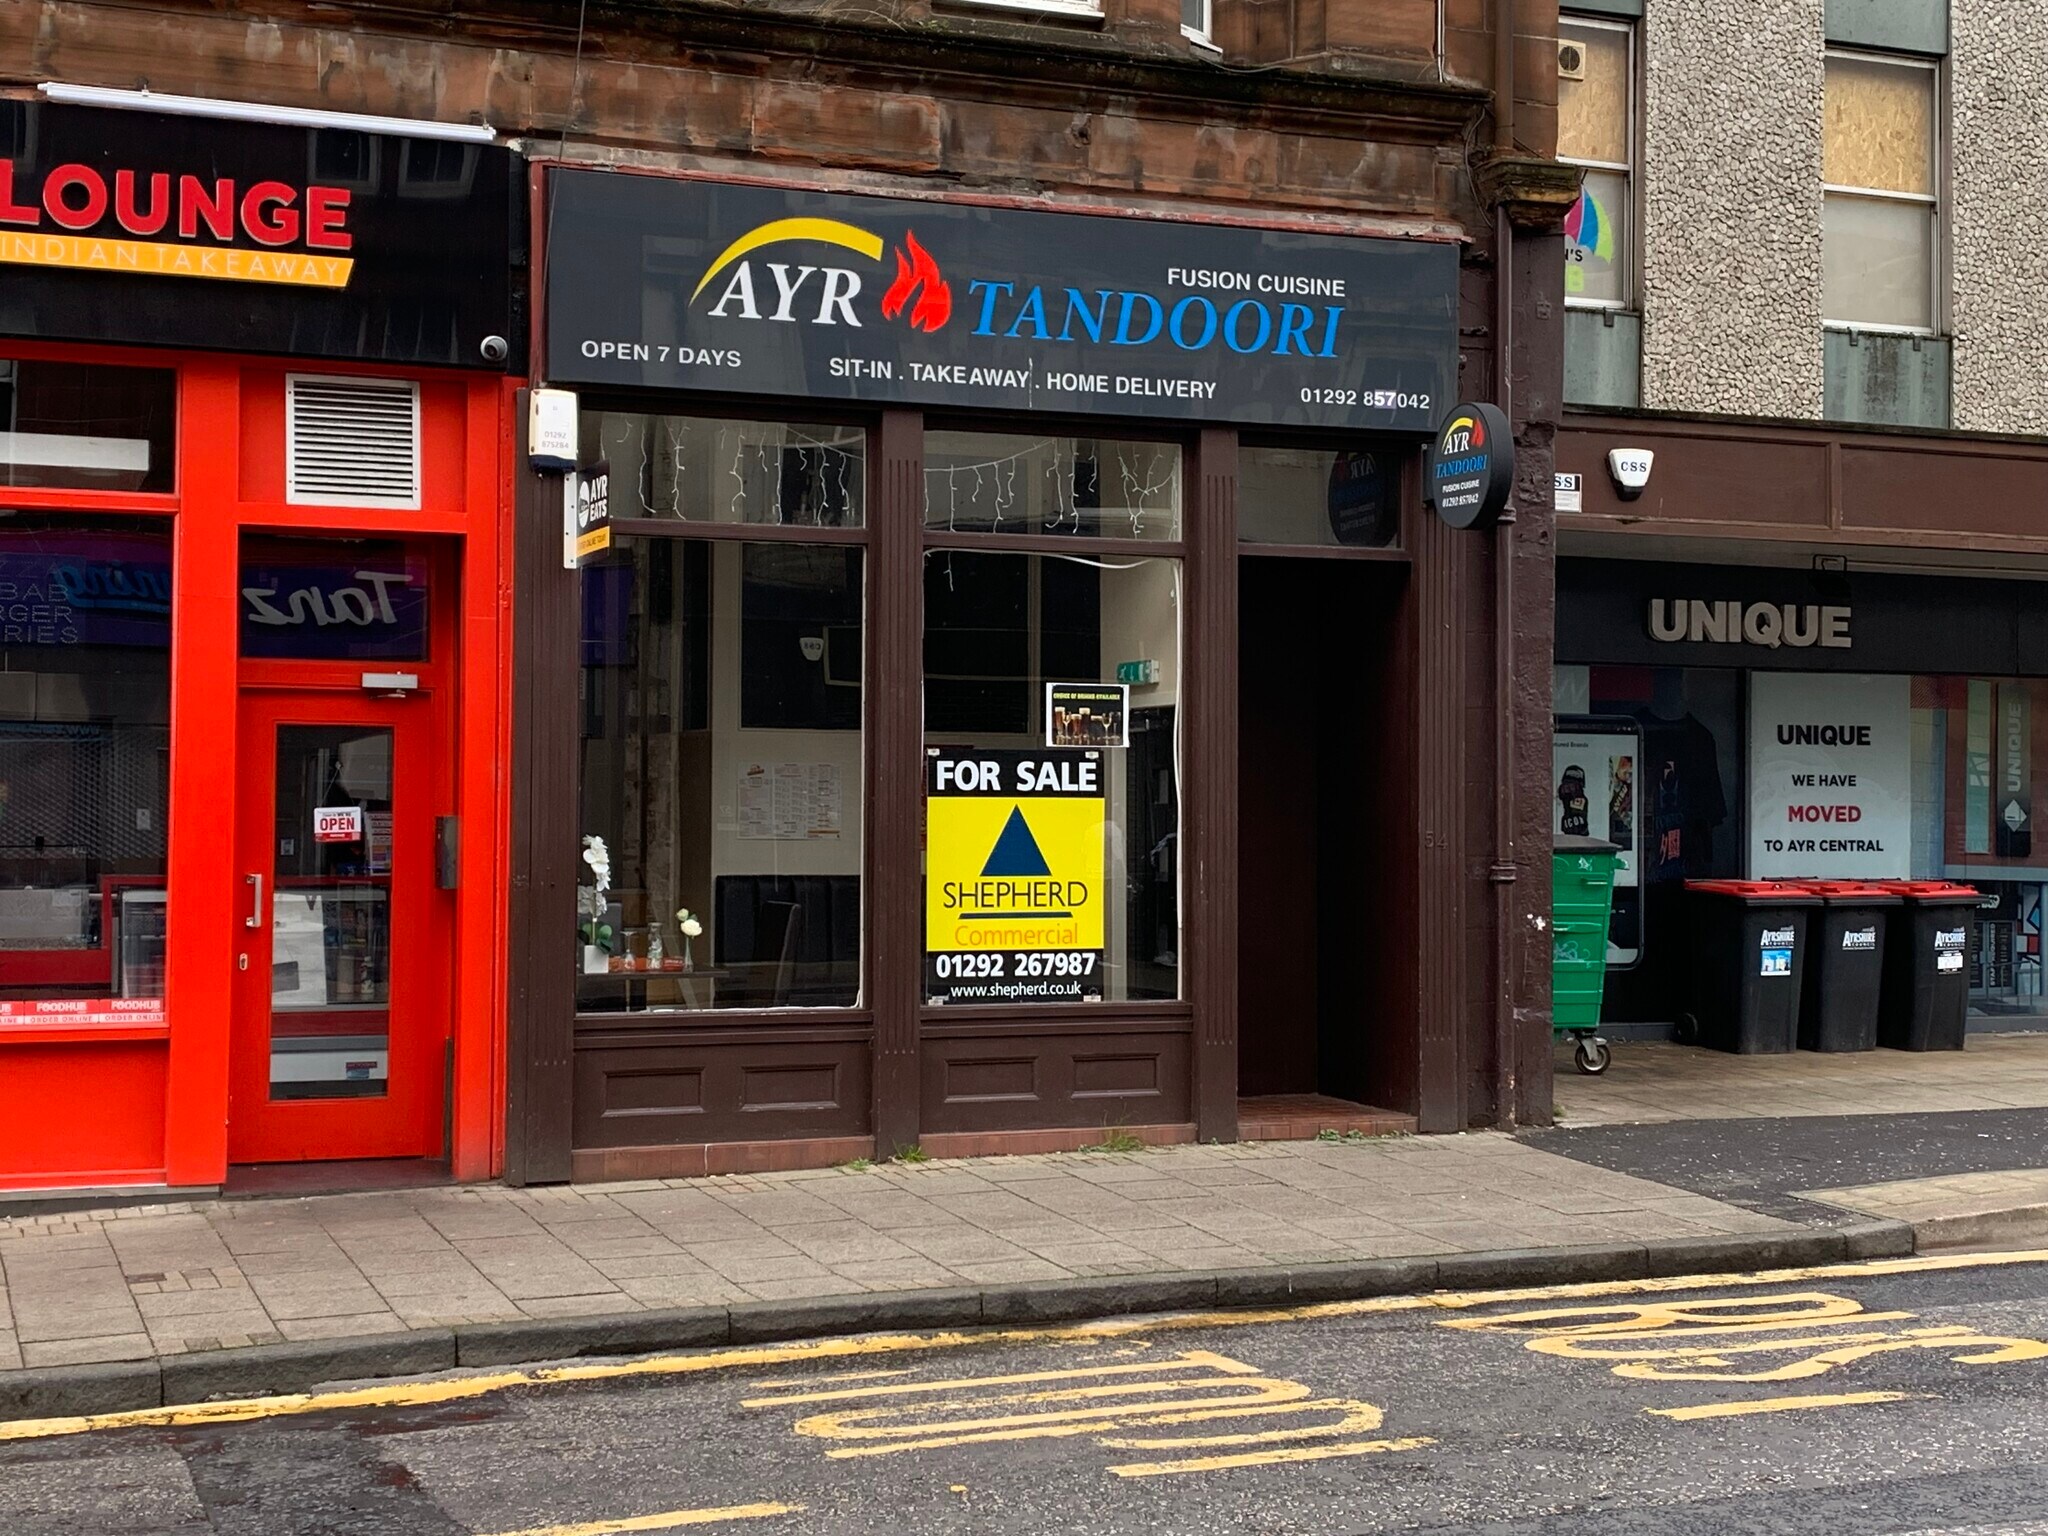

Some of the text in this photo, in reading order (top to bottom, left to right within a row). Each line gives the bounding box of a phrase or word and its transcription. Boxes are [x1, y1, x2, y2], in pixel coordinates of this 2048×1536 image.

[0, 159, 353, 250] LOUNGE
[1, 235, 338, 282] INDIAN TAKEAWAY
[707, 261, 863, 327] AYR
[1167, 268, 1346, 297] FUSION CUISINE
[968, 279, 1346, 358] TANDOORI
[581, 340, 742, 368] OPEN 7 DAYS
[830, 357, 1217, 400] SIT-IN TAKEAWAY HOME DELIVERY
[1300, 387, 1431, 410] 01292 857042
[1444, 431, 1470, 455] AYR
[1436, 454, 1488, 479] TANDOORI
[1620, 461, 1647, 473] CSS
[590, 474, 608, 500] AYR
[1442, 482, 1460, 494] FUSION
[589, 498, 608, 523] EATS
[1648, 598, 1852, 649] UNIQUE
[1777, 724, 1871, 747] UNIQUE
[2008, 703, 2022, 792] UNIQUE
[936, 760, 1097, 792] FOR SALE
[1792, 774, 1856, 787] WE HAVE
[319, 817, 355, 831] OPEN
[1788, 805, 1861, 822] MOVED
[1764, 840, 1884, 852] TO AYR CENTRAL
[943, 881, 1088, 908] SHEPHERD
[954, 923, 1078, 947] Commercial
[936, 952, 1096, 978] 01292 267987
[950, 981, 1081, 998] www.shepherd.co.uk
[36, 1001, 87, 1012] FOODHUB
[111, 1000, 161, 1011] FOODHUB
